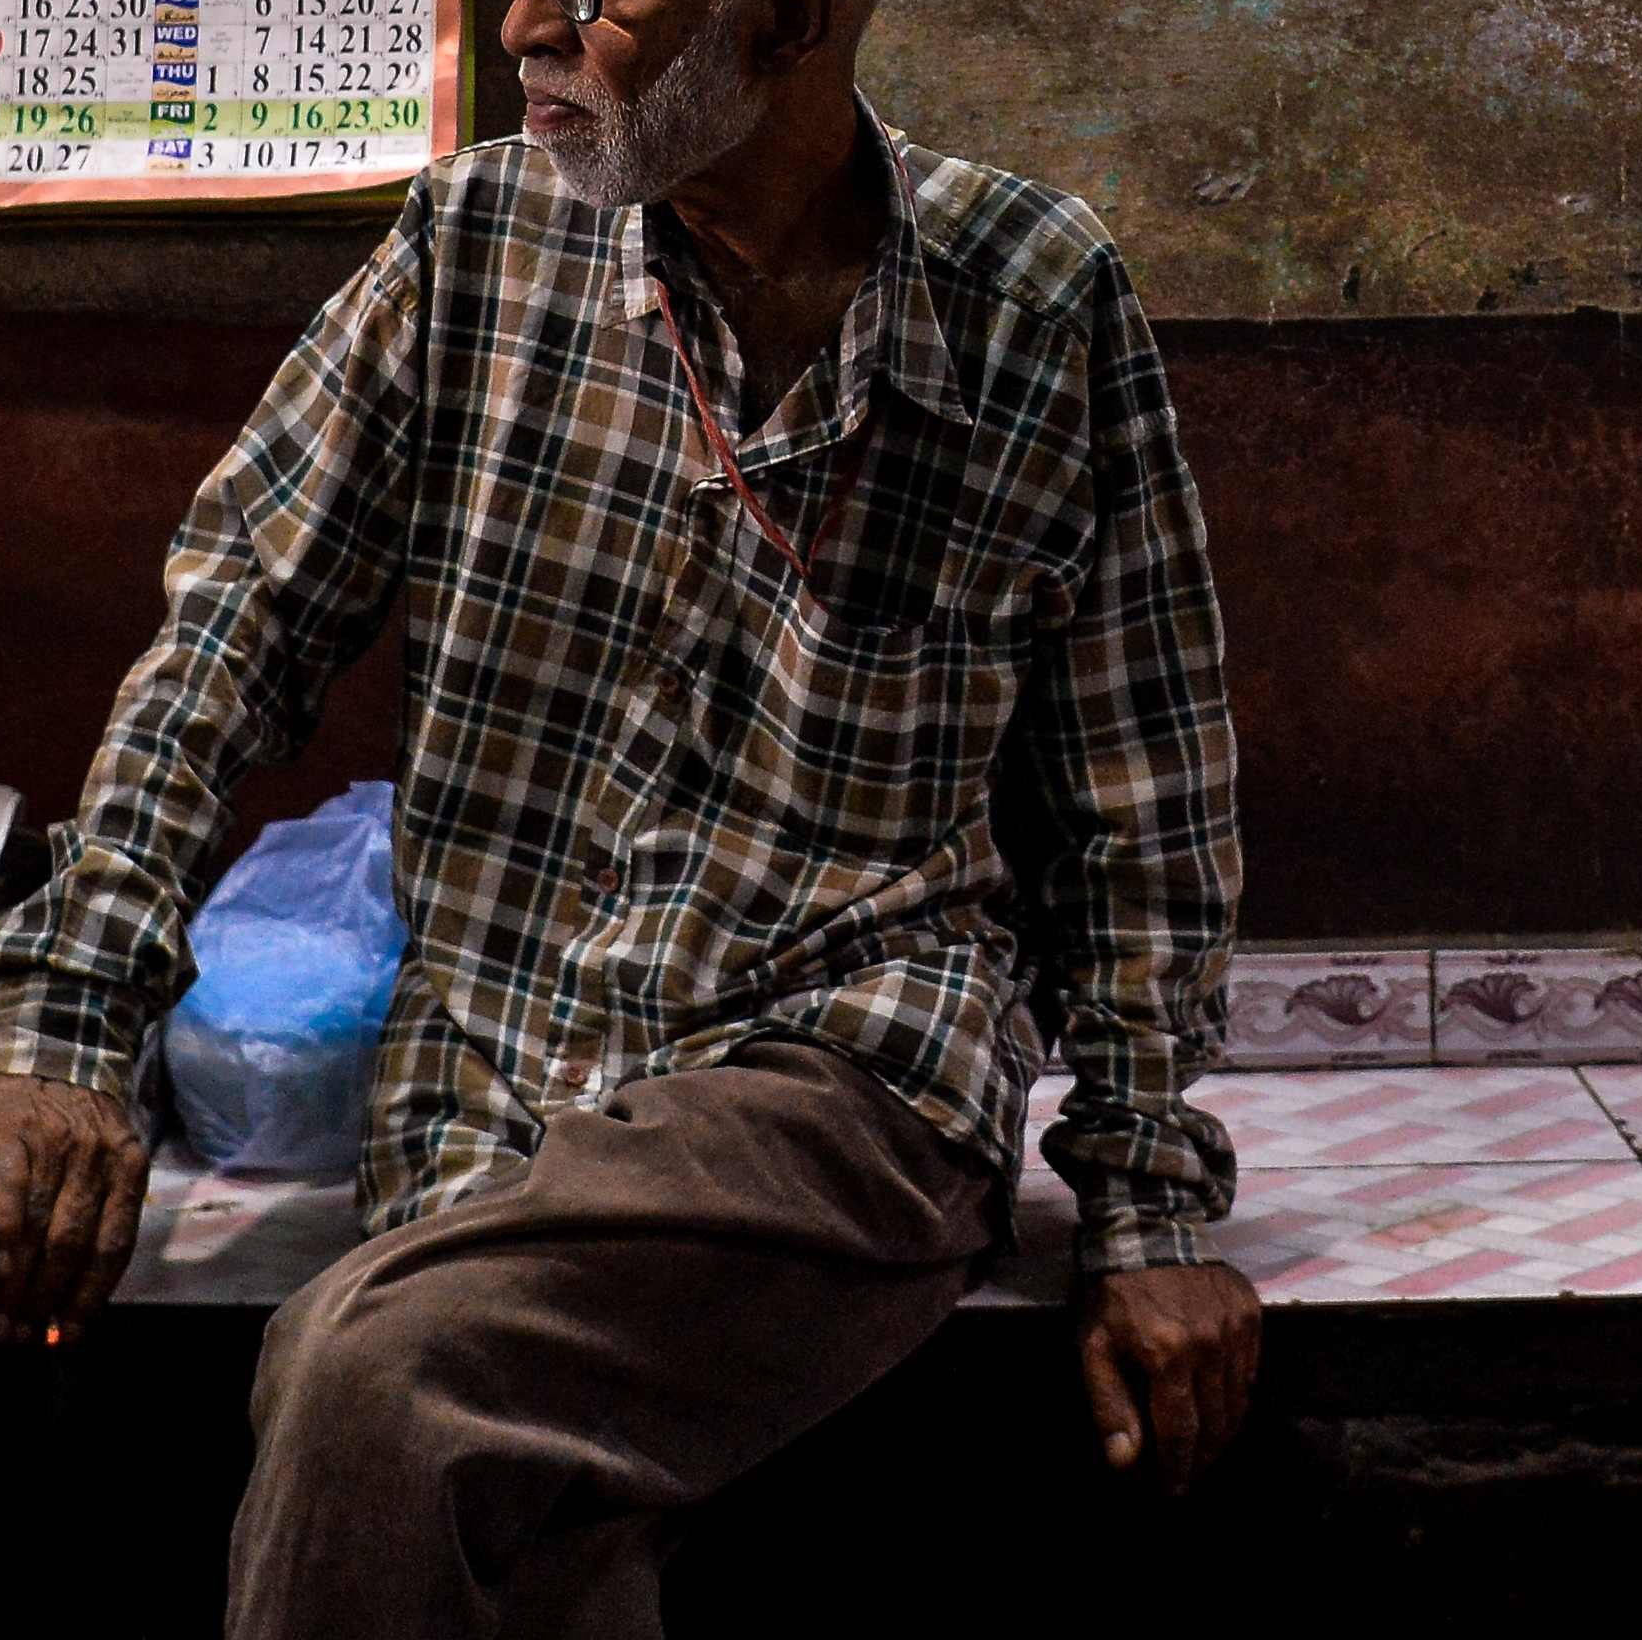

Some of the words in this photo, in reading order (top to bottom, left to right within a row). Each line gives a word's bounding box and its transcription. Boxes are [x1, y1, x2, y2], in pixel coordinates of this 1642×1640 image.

[19, 28, 50, 57] 17
[63, 28, 96, 57] 24
[109, 27, 142, 57] 31
[157, 27, 196, 40] WED
[257, 27, 271, 55] 7
[295, 27, 325, 53] 14
[340, 26, 370, 52] 21
[388, 25, 422, 53] 28
[17, 68, 49, 95] 18
[62, 67, 96, 95] 25
[157, 65, 194, 78] THU
[208, 65, 217, 94] 1
[253, 65, 269, 92] 8
[294, 65, 324, 92] 15
[339, 63, 372, 91] 22
[387, 62, 420, 91] 29
[15, 106, 48, 134] 19
[60, 106, 94, 132] 26
[158, 104, 190, 119] FRI
[205, 103, 217, 131] 2
[252, 103, 268, 131] 9
[292, 102, 323, 131] 16
[337, 101, 370, 129] 23
[384, 99, 419, 128] 30
[9, 145, 43, 172] 20
[57, 144, 91, 171] 27
[152, 141, 187, 155] SAT
[198, 142, 214, 168] 3
[244, 142, 274, 168] 10
[289, 142, 320, 168] 17
[335, 140, 367, 165] 24
